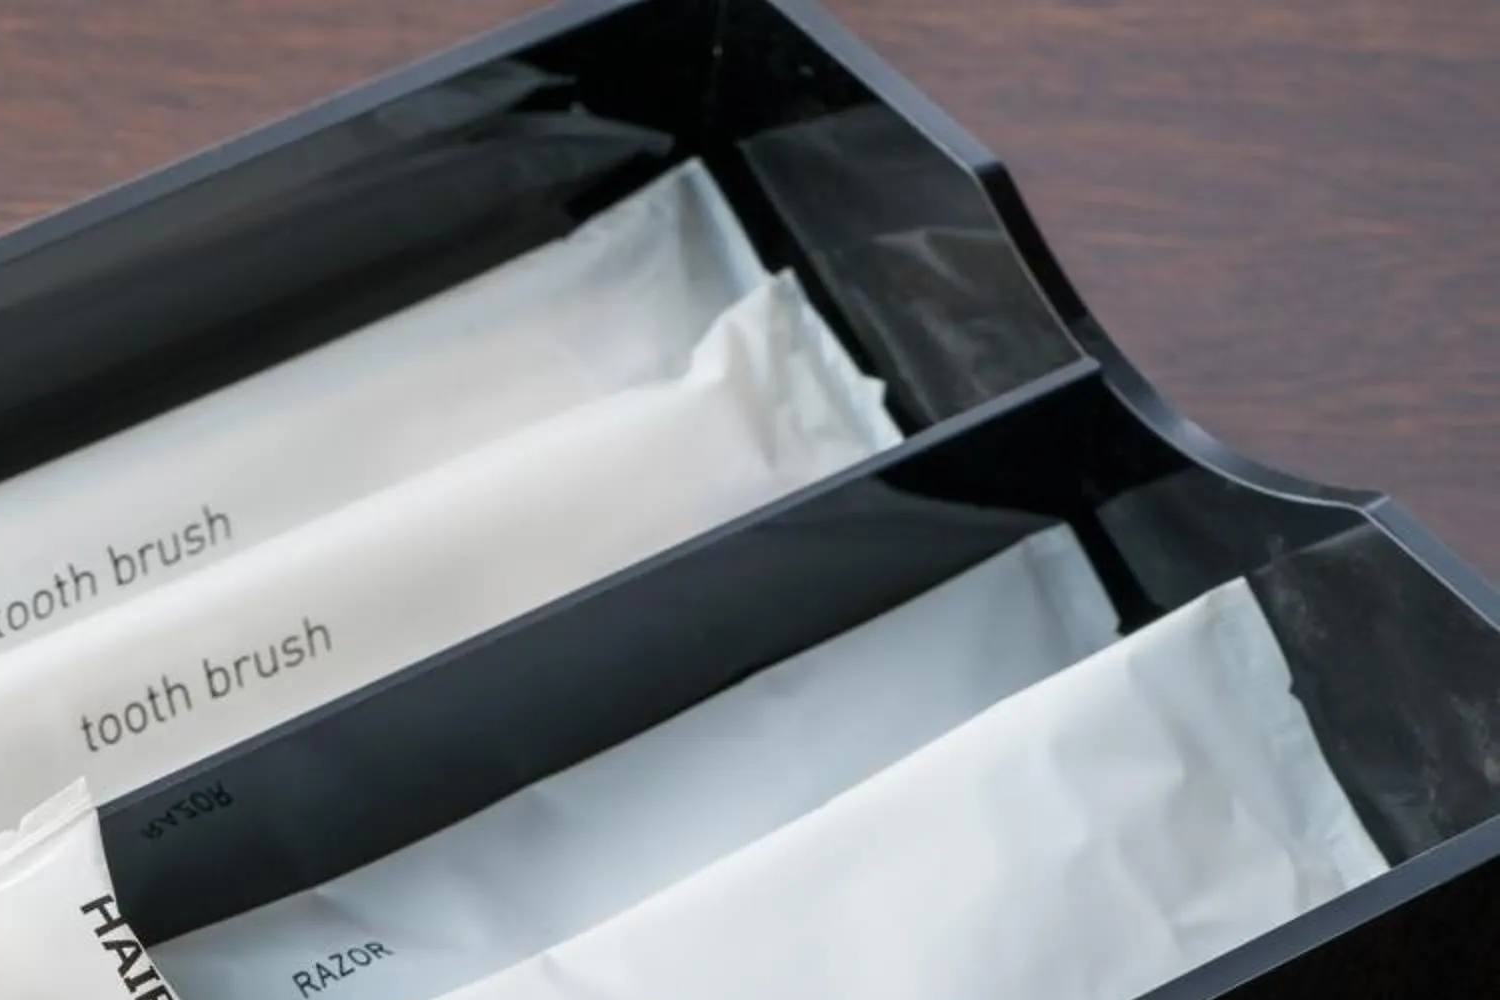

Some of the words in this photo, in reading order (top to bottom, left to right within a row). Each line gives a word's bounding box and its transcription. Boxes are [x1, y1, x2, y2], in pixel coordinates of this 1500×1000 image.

[106, 505, 232, 587] brush
[80, 675, 193, 753] tooth
[203, 617, 332, 700] brush
[291, 941, 394, 999] RAZOR
